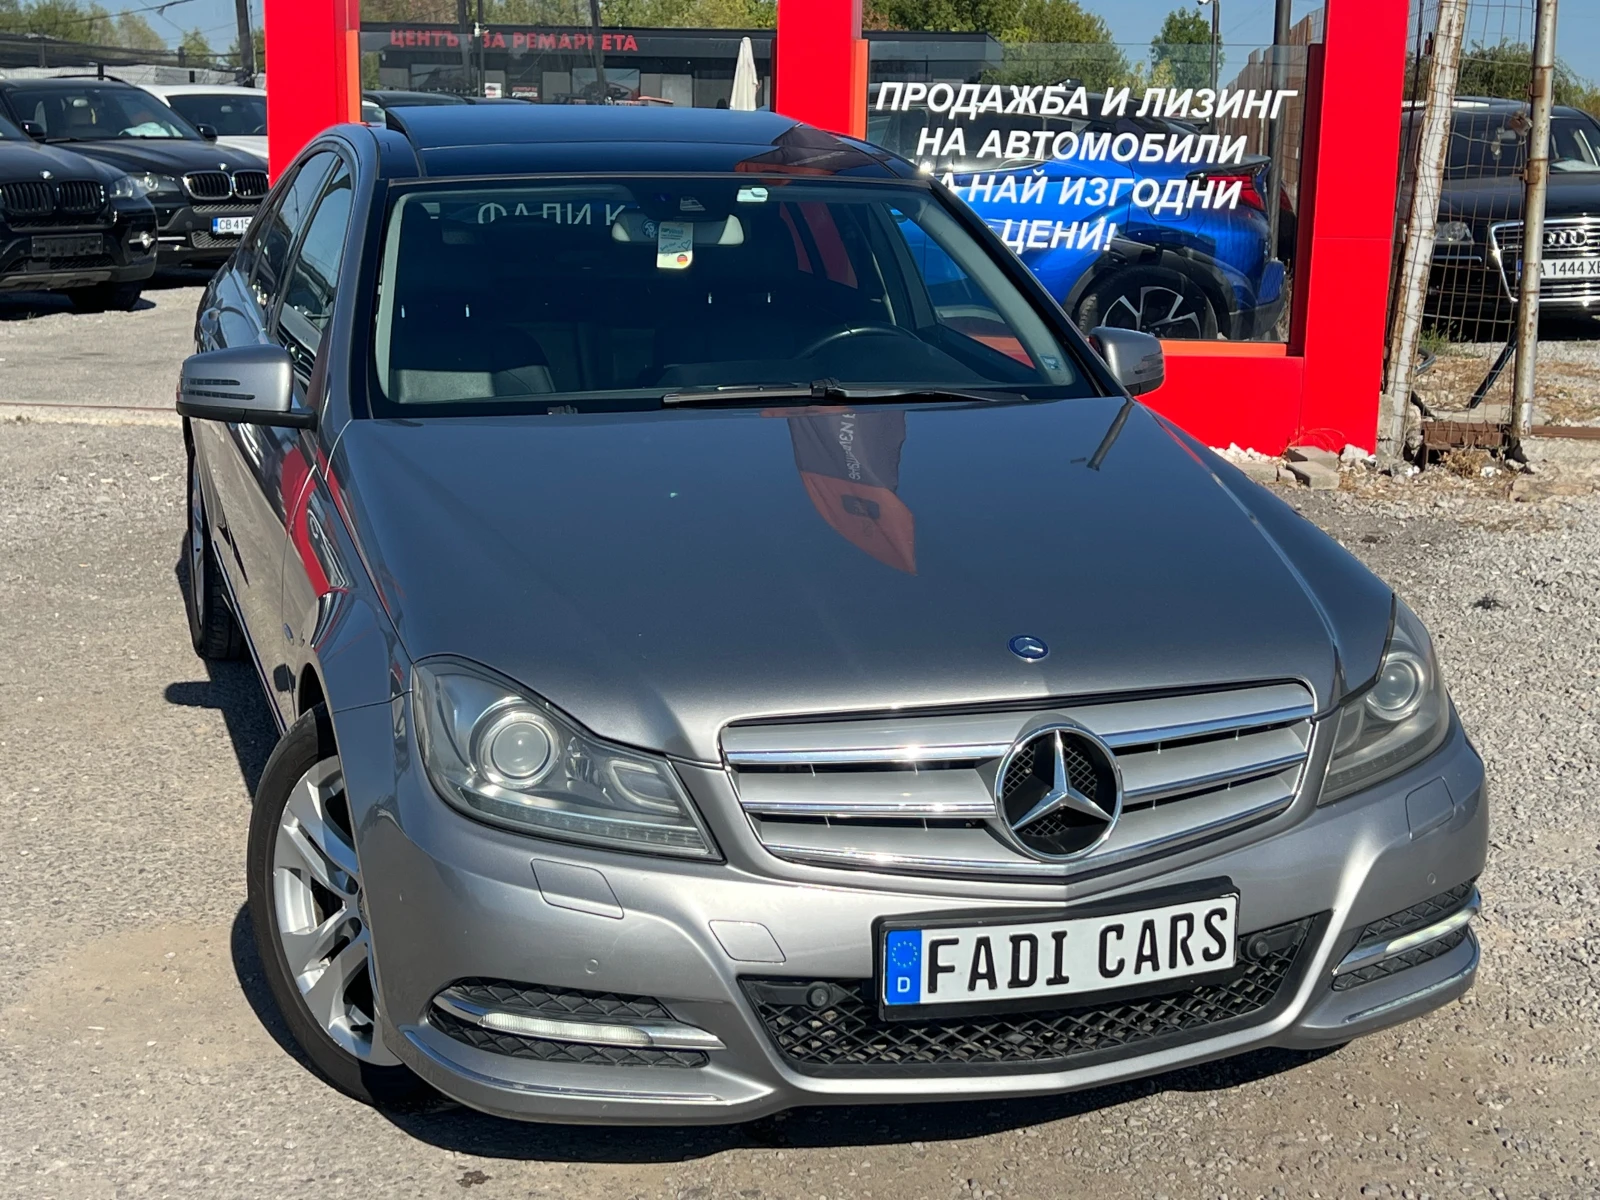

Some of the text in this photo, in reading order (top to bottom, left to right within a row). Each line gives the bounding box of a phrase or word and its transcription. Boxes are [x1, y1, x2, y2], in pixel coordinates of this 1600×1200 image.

[391, 30, 472, 47] ЦЕНТЪ
[876, 82, 1298, 120] ПРОДАЖБА И ЛИЗИНГ
[916, 127, 1247, 164] НА АВТОМОБИЛИ
[968, 169, 1048, 204] НАЙ
[1058, 177, 1242, 215] ИЗГОДНИ
[1001, 219, 1116, 254] ЦЕНИ!
[1552, 261, 1584, 276] 1444
[927, 907, 1227, 994] FADI CARS
[897, 976, 910, 993] D
